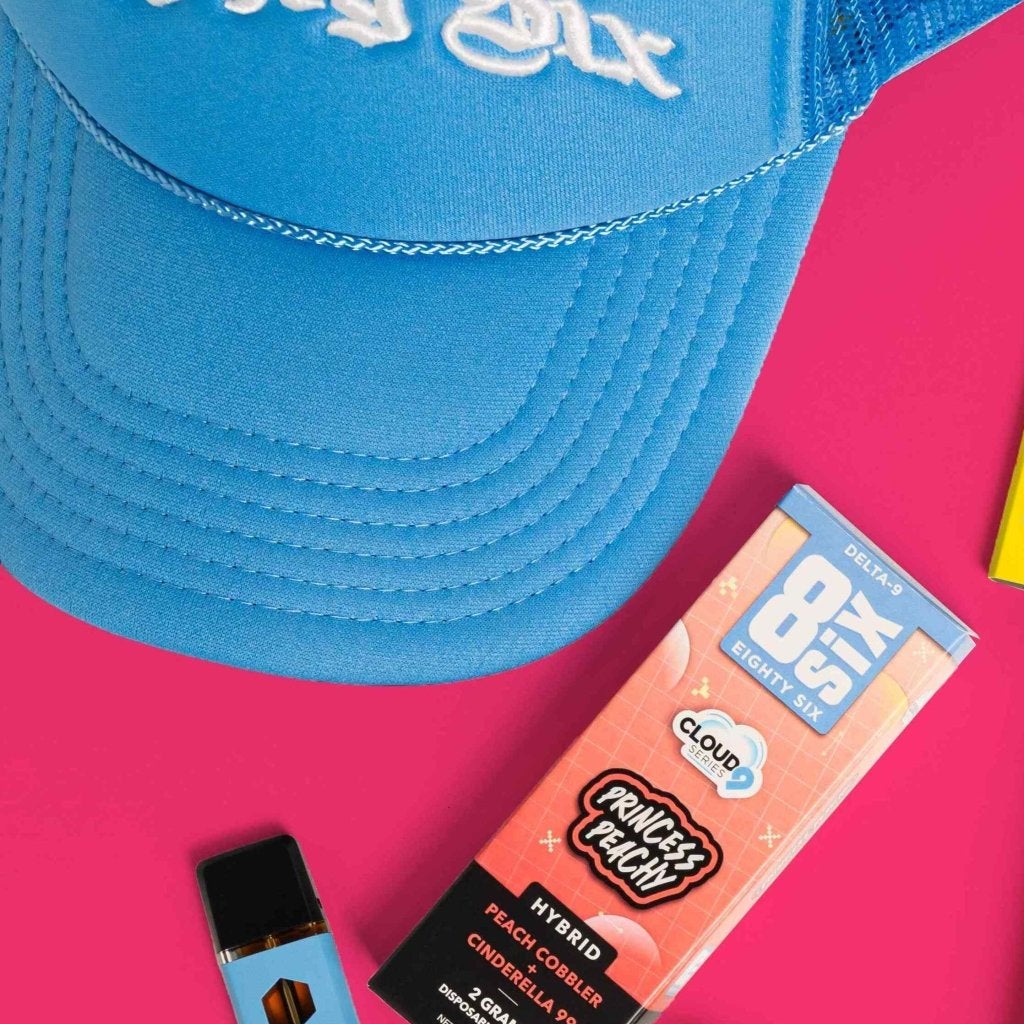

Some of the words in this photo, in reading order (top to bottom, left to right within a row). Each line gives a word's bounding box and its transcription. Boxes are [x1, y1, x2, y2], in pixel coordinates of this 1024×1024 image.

[843, 543, 903, 597] DELTA-9
[748, 554, 852, 664] 8
[731, 640, 794, 694] EIGHTY
[793, 692, 823, 722] SIX
[679, 716, 740, 771] CLOUD
[688, 743, 725, 778] SERIES
[585, 820, 677, 891] PEACHY
[596, 786, 704, 870] PRINCESS
[485, 902, 537, 950] PEACH
[535, 947, 604, 1009] COBBLER
[531, 897, 601, 962] HYBRID
[467, 933, 554, 1015] CINDERELLA
[467, 987, 481, 1001] 2
